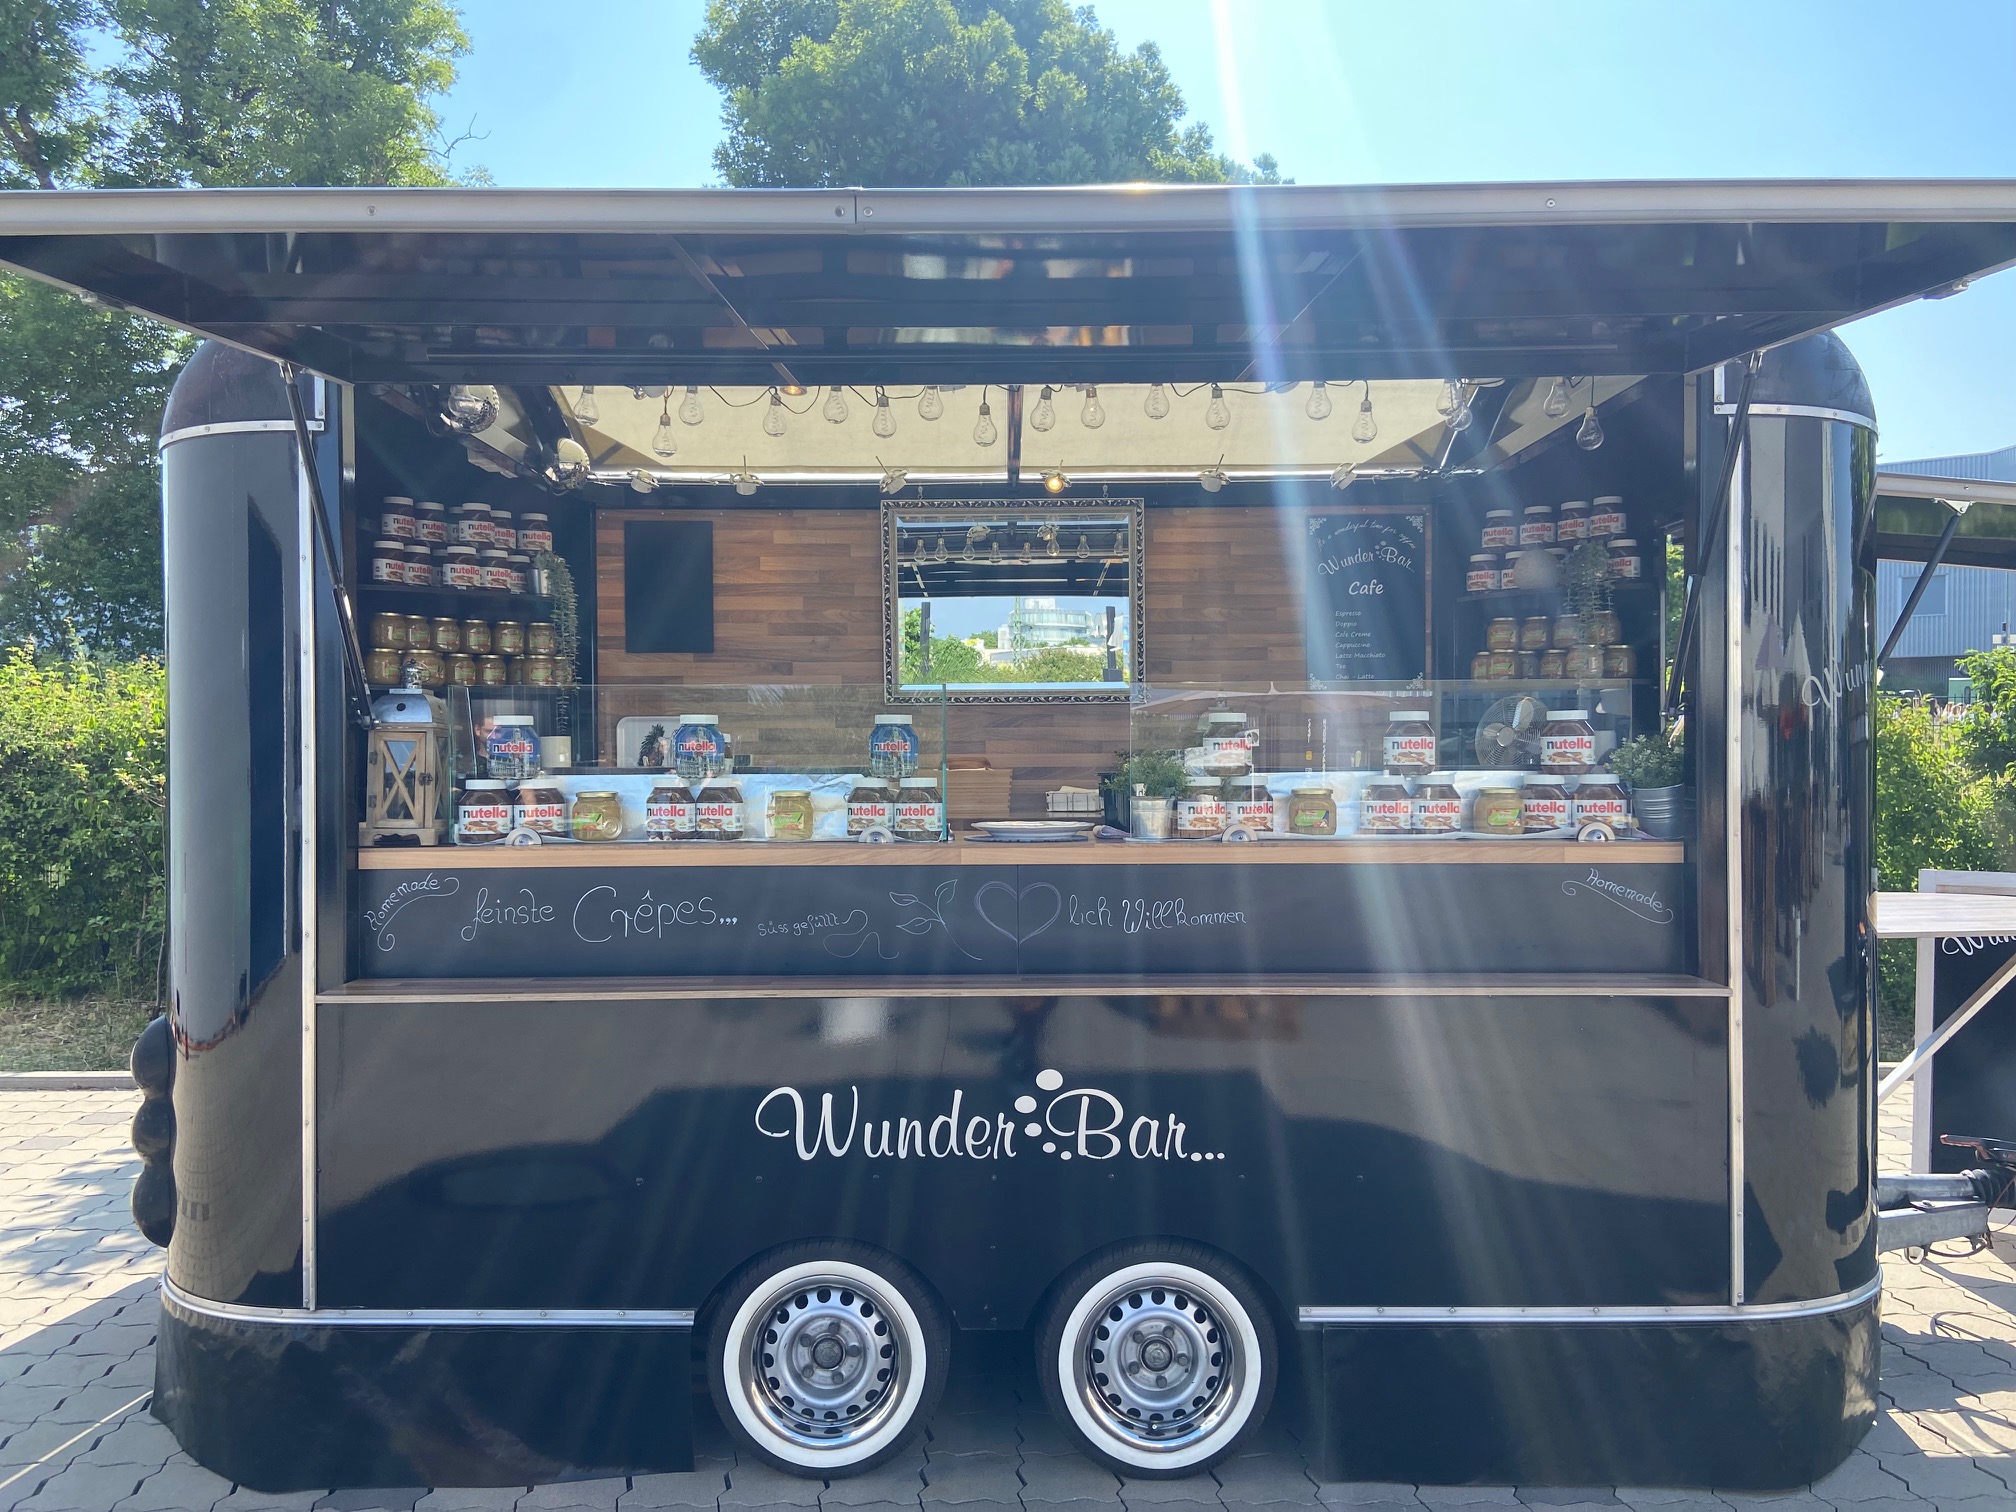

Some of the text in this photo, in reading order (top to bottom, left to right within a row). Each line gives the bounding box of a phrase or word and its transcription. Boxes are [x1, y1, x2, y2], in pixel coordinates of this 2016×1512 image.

[1483, 527, 1513, 537] nutella
[1521, 524, 1552, 534] nutella
[522, 532, 551, 541] nutella
[1318, 548, 1374, 575] Wunder
[450, 566, 480, 575] nutella
[1348, 579, 1384, 596] Cafe
[1335, 610, 1362, 618] Espresso
[493, 741, 534, 753] nutella
[678, 740, 717, 752] nutella
[873, 739, 911, 752] nutella
[1392, 738, 1434, 750] nutella
[1547, 737, 1592, 749] nutella
[463, 806, 508, 818] nutella
[518, 805, 563, 818] nutella
[647, 805, 686, 817] nutella
[847, 804, 886, 817] nutella
[896, 804, 935, 817] nutella
[1237, 802, 1273, 815] nutella
[1366, 802, 1409, 814] nutella
[1418, 802, 1460, 814] nutella
[1576, 801, 1623, 813] nutella
[1586, 867, 1664, 913] Homemade
[364, 872, 441, 931] Homemade
[1069, 894, 1247, 934] lich Willkommen
[793, 912, 840, 936] gefüllt
[754, 1085, 1017, 1161] Wunder
